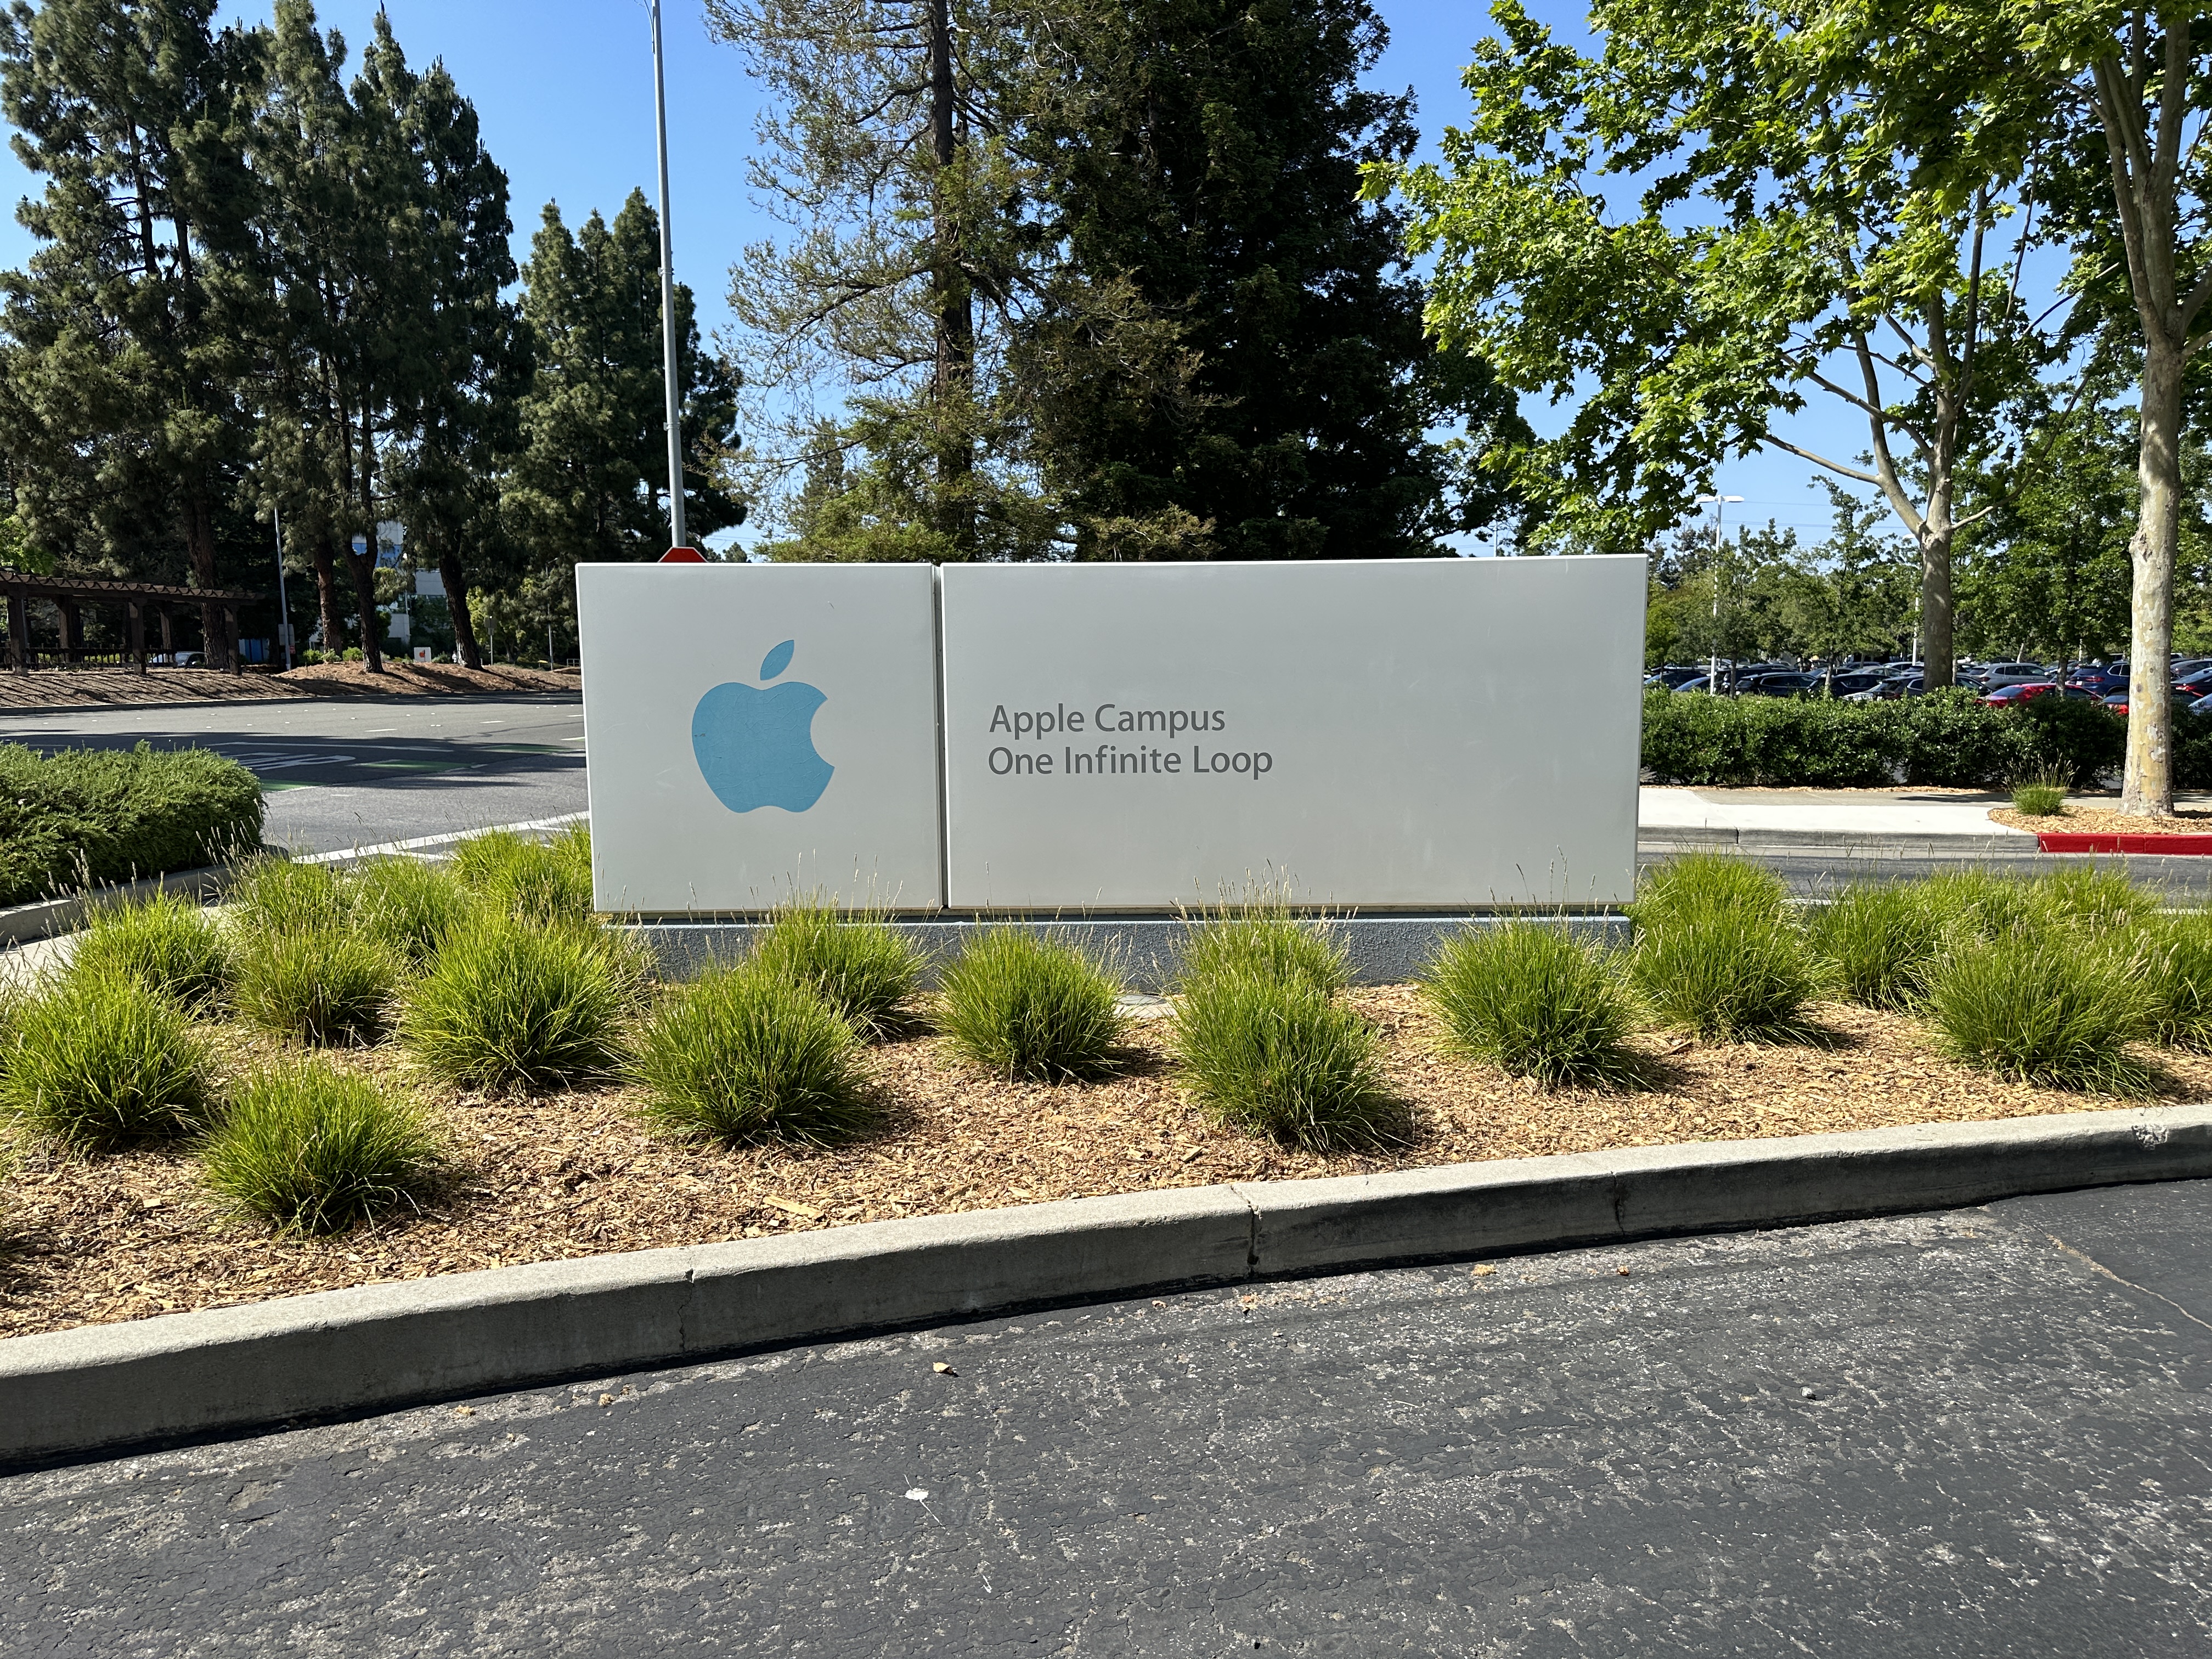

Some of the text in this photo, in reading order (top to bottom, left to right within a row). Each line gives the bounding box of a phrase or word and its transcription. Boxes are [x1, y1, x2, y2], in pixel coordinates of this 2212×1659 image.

[989, 703, 1225, 740] Apple Campus
[989, 745, 1273, 780] One Infinite Loop
